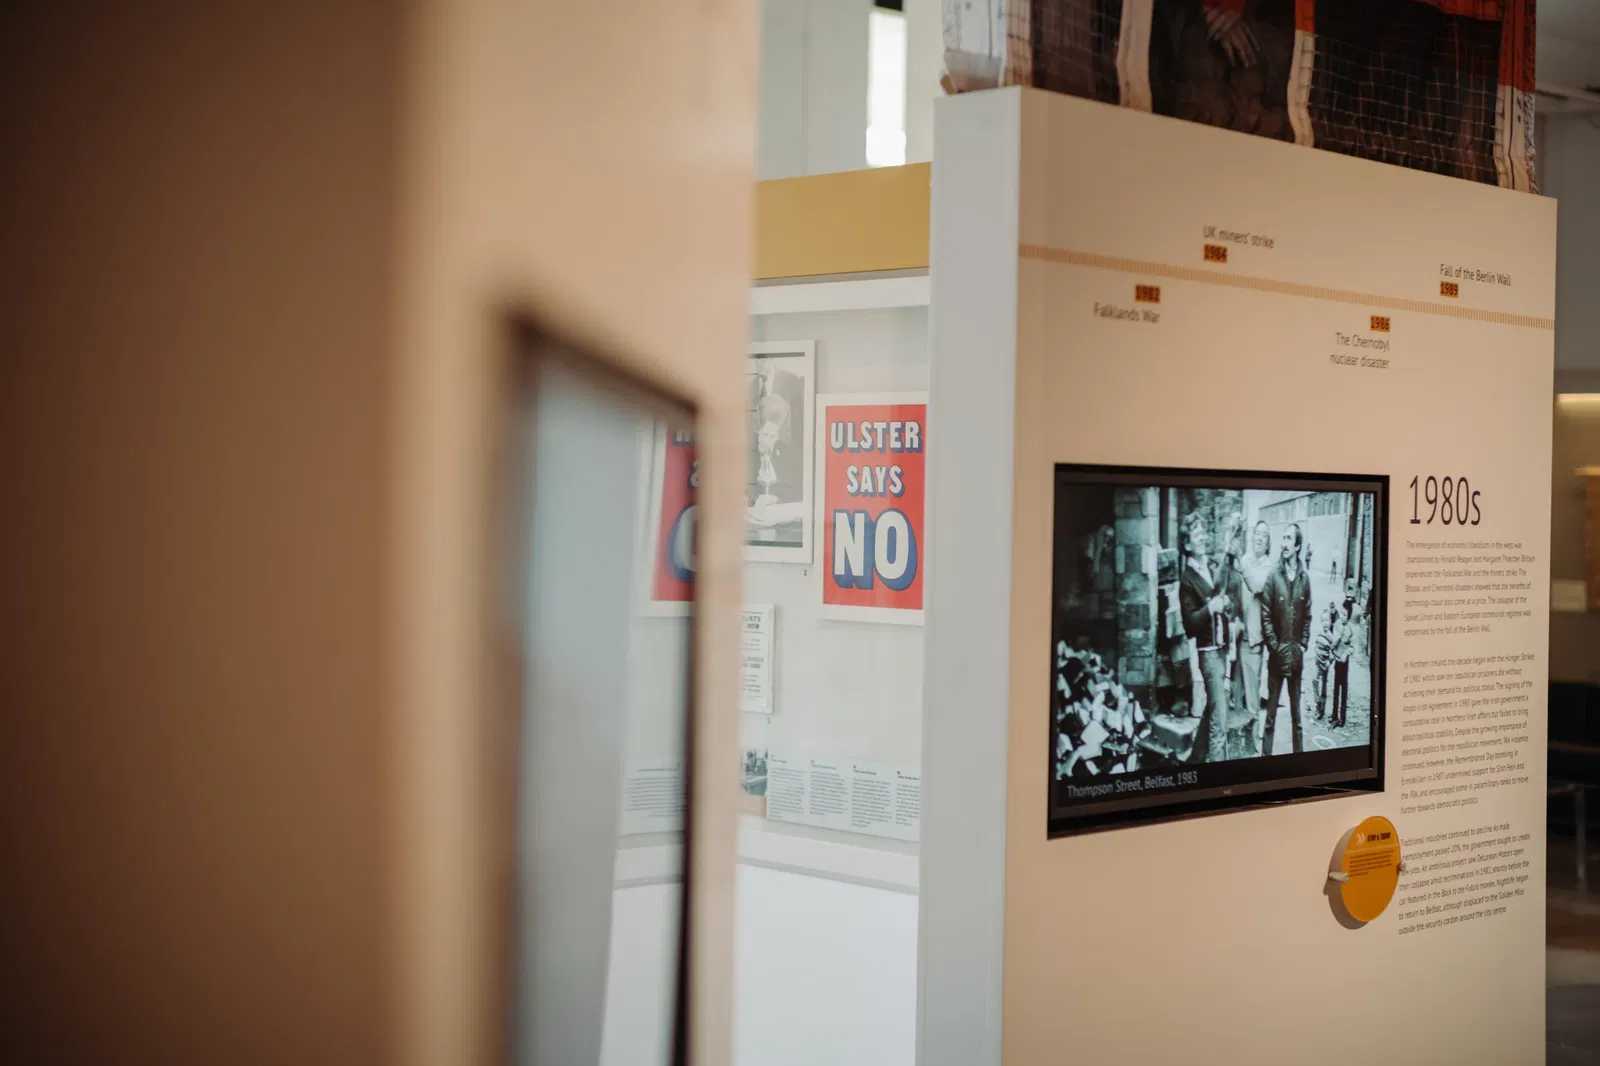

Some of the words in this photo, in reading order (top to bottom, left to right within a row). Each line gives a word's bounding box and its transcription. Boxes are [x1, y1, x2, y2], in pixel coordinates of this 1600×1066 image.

[1203, 225, 1217, 239] UK
[1251, 232, 1275, 249] strike
[1204, 245, 1227, 262] 1984
[1440, 264, 1453, 277] Fall
[1454, 266, 1462, 279] of
[1463, 267, 1475, 281] the
[1476, 269, 1496, 284] Berlin
[1497, 273, 1512, 287] Wall
[1440, 281, 1458, 298] 1989
[1093, 302, 1140, 322] Falklands
[1142, 308, 1160, 324] War
[1370, 315, 1390, 332] 1986
[1336, 332, 1350, 346] The
[1351, 334, 1390, 352] Chernobyl
[1330, 353, 1359, 367] nuclear
[1361, 355, 1390, 369] disaster
[830, 420, 922, 454] ULSTER
[846, 464, 905, 498] SAYS
[1410, 475, 1481, 525] 1980s
[832, 508, 918, 591] NO
[1067, 784, 1114, 798] Thompson
[1116, 779, 1144, 793] Street,
[1145, 774, 1176, 789] Belfast,
[1177, 771, 1198, 785] 1983
[1402, 848, 1434, 861] nemployment
